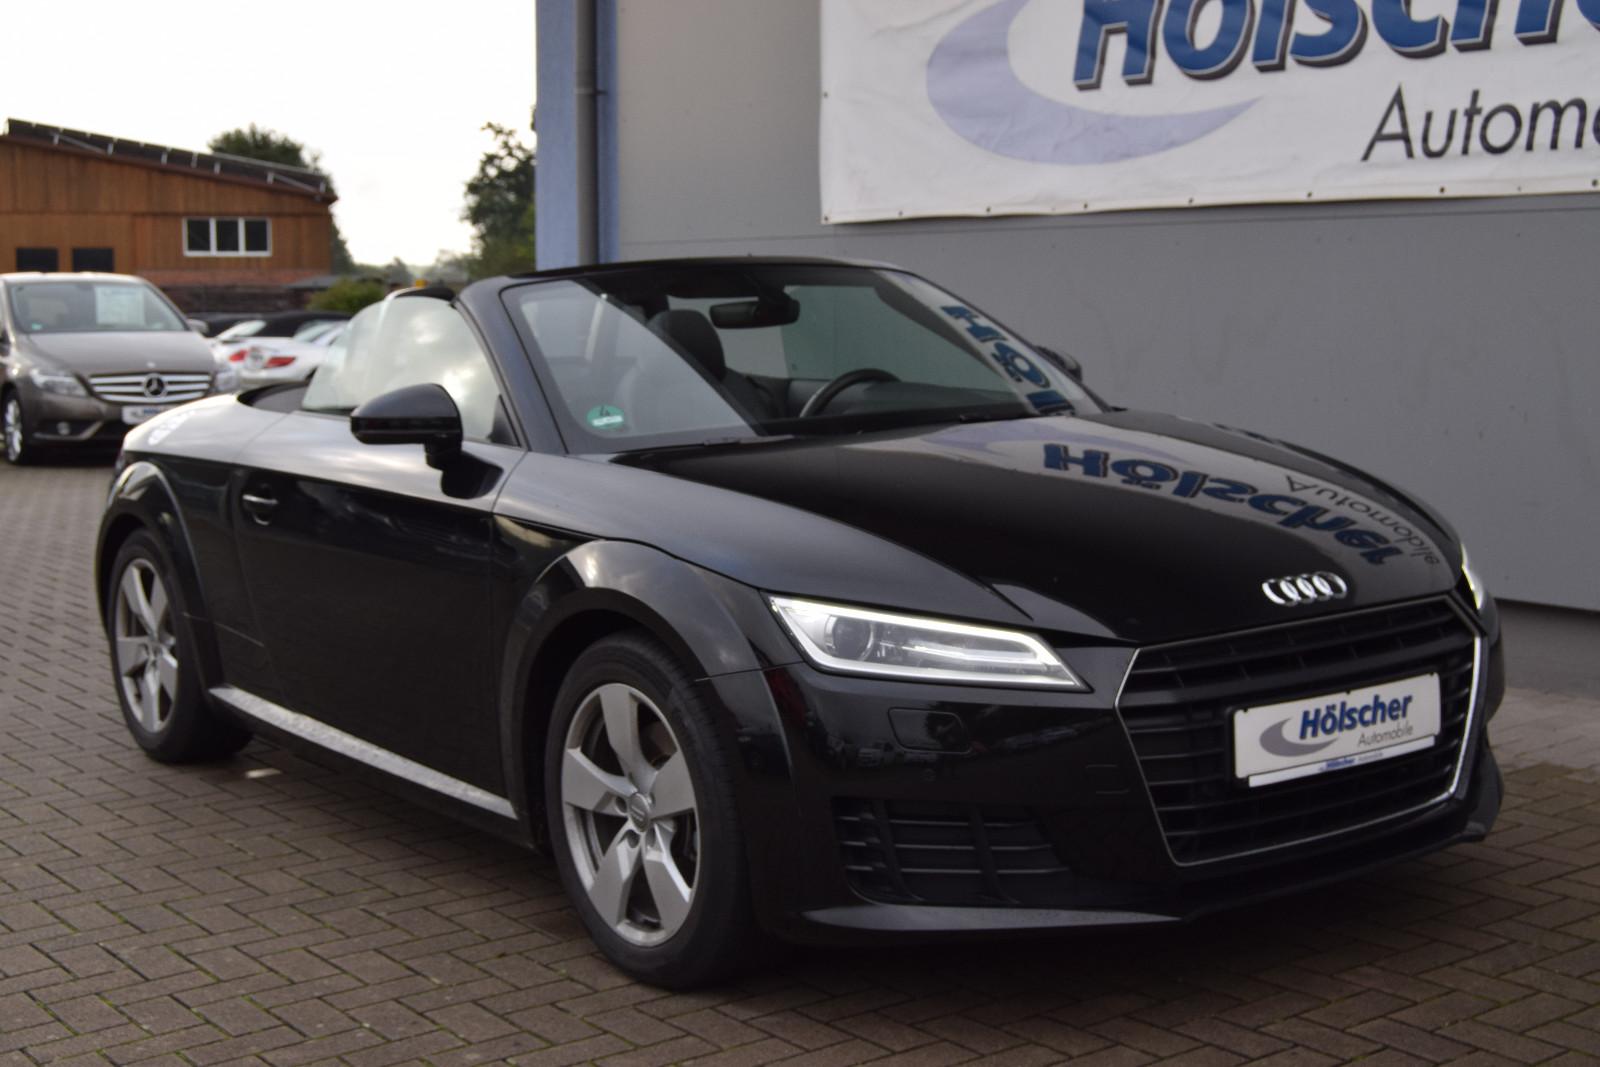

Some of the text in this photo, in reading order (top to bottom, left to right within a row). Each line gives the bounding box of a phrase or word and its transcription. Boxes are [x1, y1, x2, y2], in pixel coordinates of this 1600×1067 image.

[1361, 82, 1600, 161] Autom
[1299, 695, 1413, 739] Hölscher
[1357, 721, 1414, 748] Automobile
